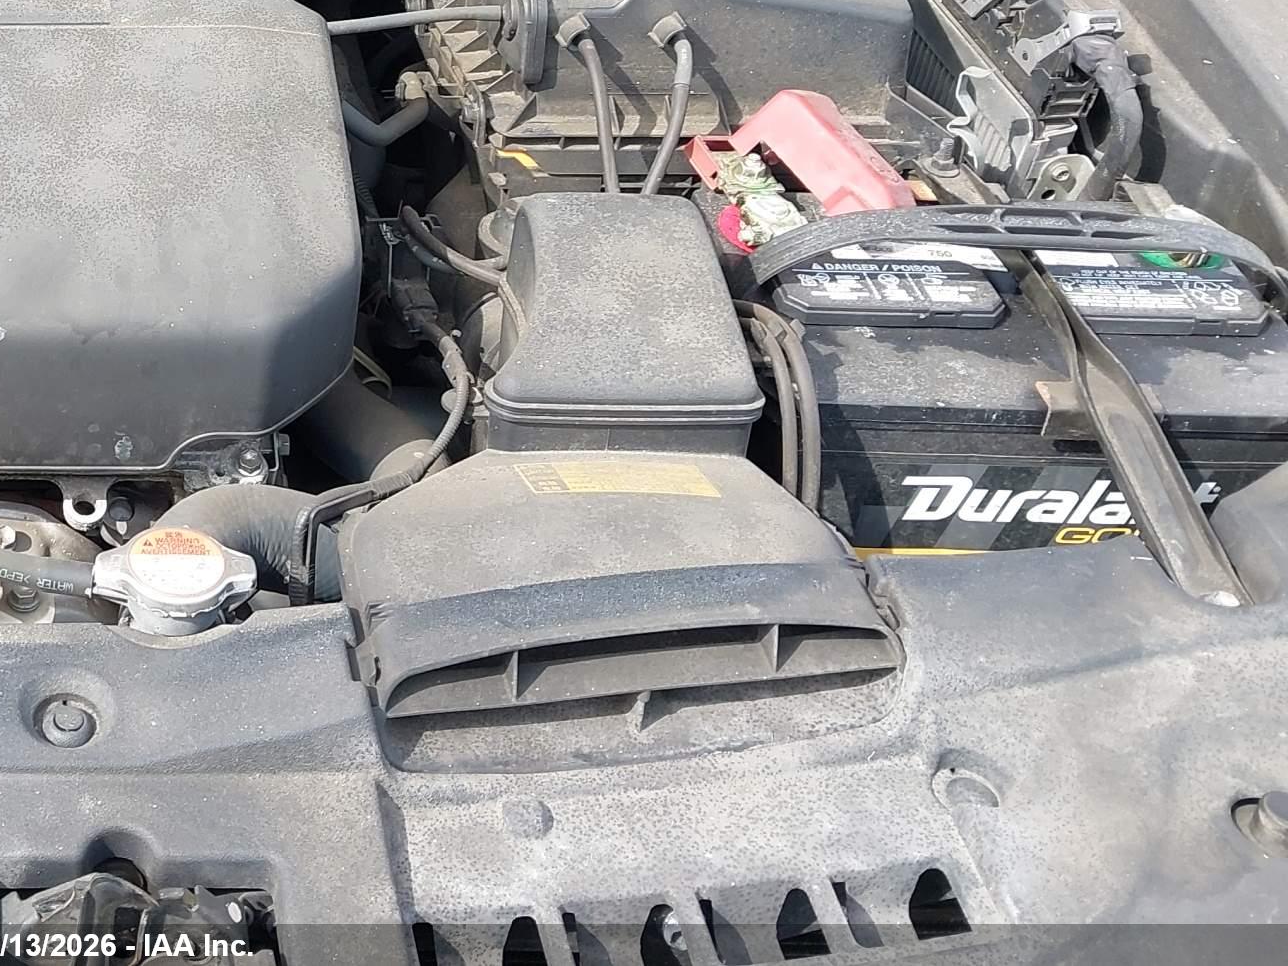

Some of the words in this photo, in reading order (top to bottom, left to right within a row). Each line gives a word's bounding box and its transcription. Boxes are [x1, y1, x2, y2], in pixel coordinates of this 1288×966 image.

[824, 263, 880, 272] DANGER
[893, 264, 942, 273] POISON
[902, 475, 1221, 524] Duralat
[155, 537, 201, 545] WARNING
[1055, 527, 1140, 545] GO
[36, 577, 74, 593] WATER
